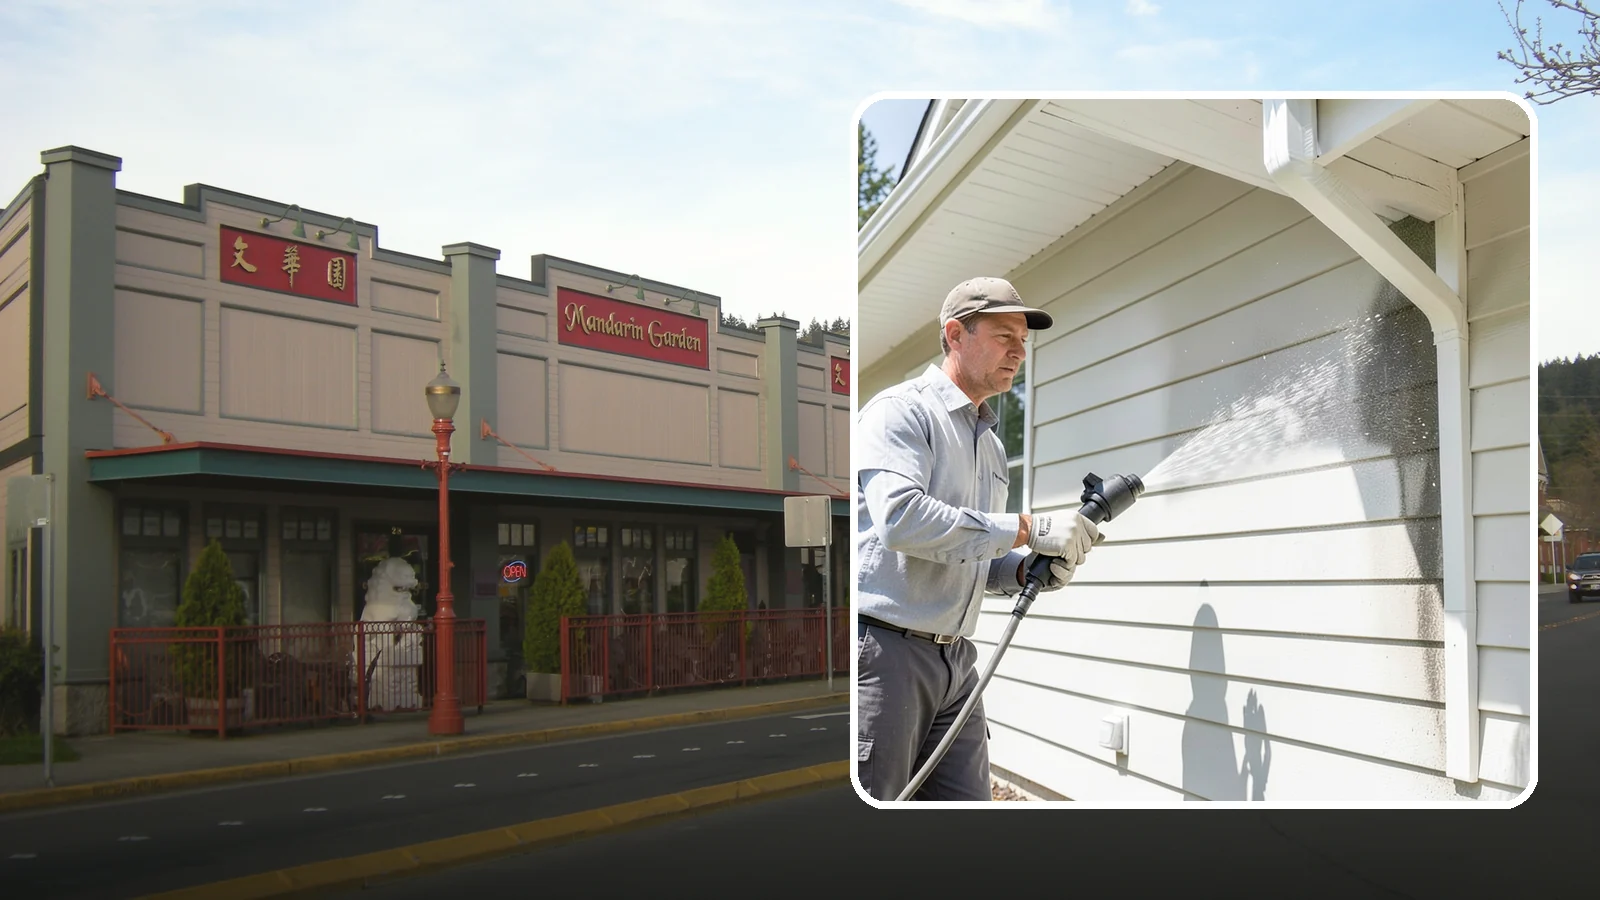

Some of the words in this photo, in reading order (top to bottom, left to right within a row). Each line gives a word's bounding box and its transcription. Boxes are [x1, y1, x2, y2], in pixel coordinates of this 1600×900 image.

[564, 302, 644, 341] Mandarin
[647, 320, 702, 352] Garden
[502, 565, 527, 578] OPEN
